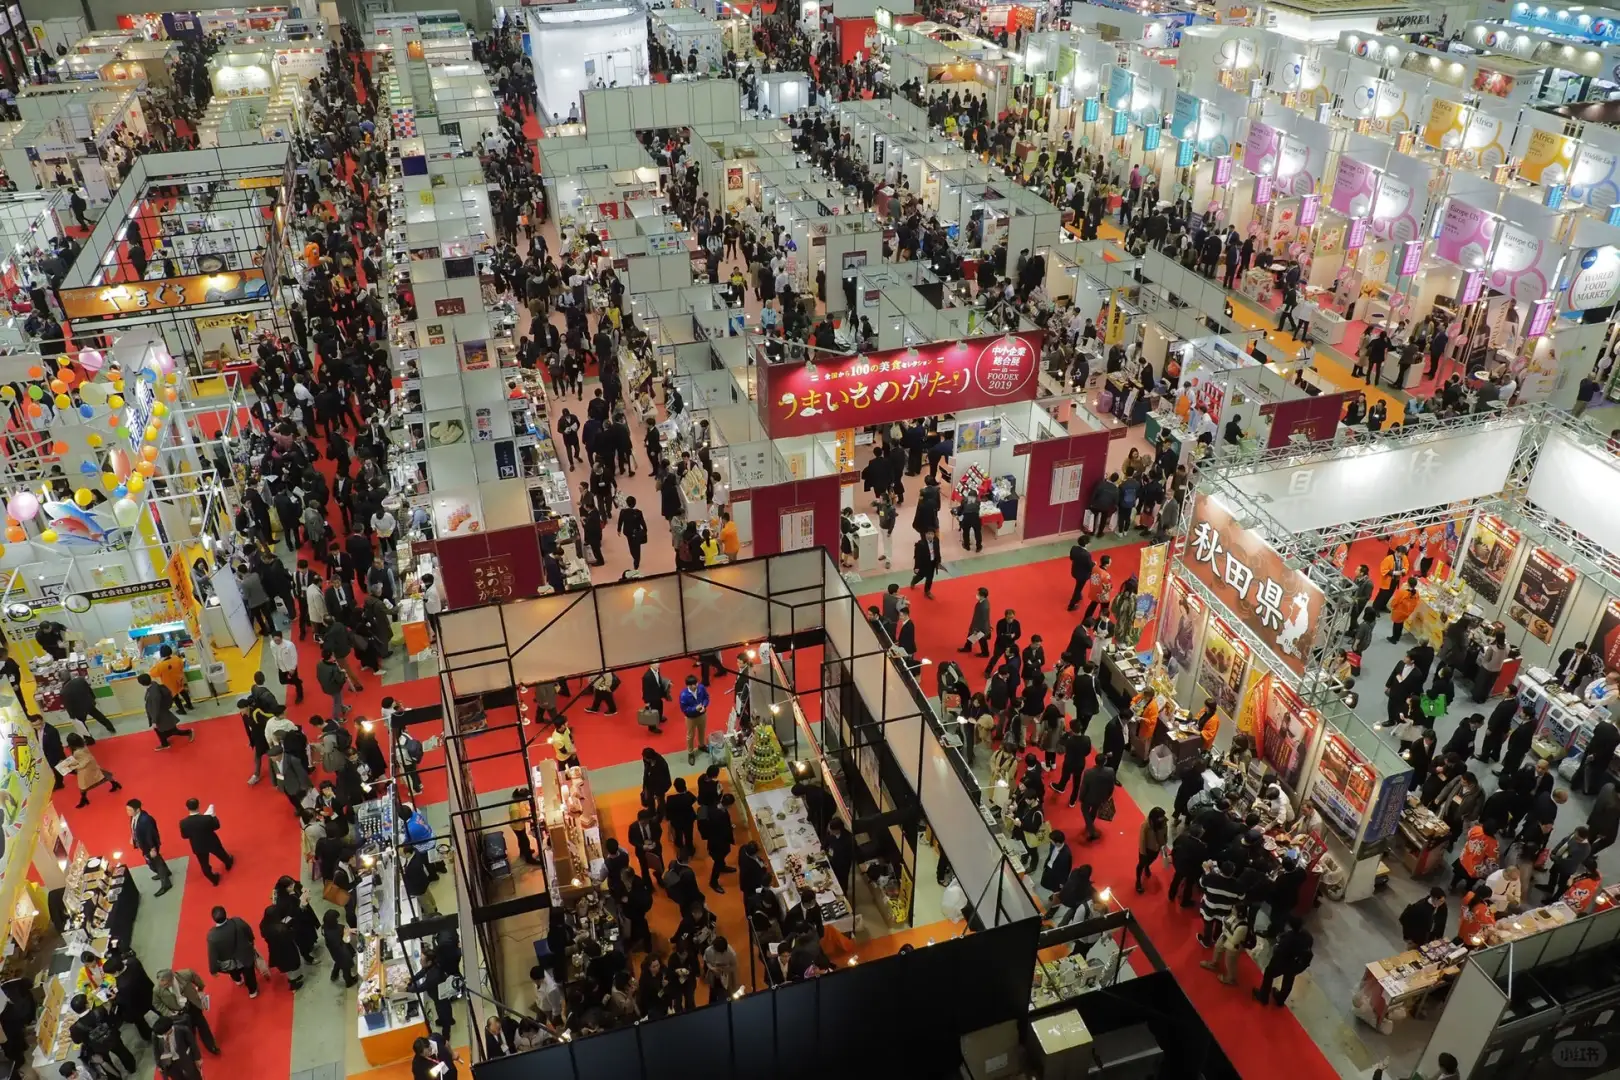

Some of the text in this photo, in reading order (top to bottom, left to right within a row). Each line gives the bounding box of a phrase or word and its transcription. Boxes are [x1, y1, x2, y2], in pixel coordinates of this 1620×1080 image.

[1395, 14, 1431, 27] KOREA
[1434, 100, 1453, 112] Africa
[1534, 131, 1555, 145] Africa
[1450, 204, 1479, 222] Europe CIS
[1505, 231, 1538, 251] Europe CIS
[1584, 270, 1614, 282] WORLD
[1583, 281, 1607, 292] FOOD
[99, 282, 186, 312] やまぐち
[1576, 289, 1612, 301] MARKET
[991, 345, 1027, 358] 中小企業
[987, 373, 1020, 381] FOODEX
[988, 380, 1013, 390] 2019
[1190, 522, 1286, 631] 秋田県
